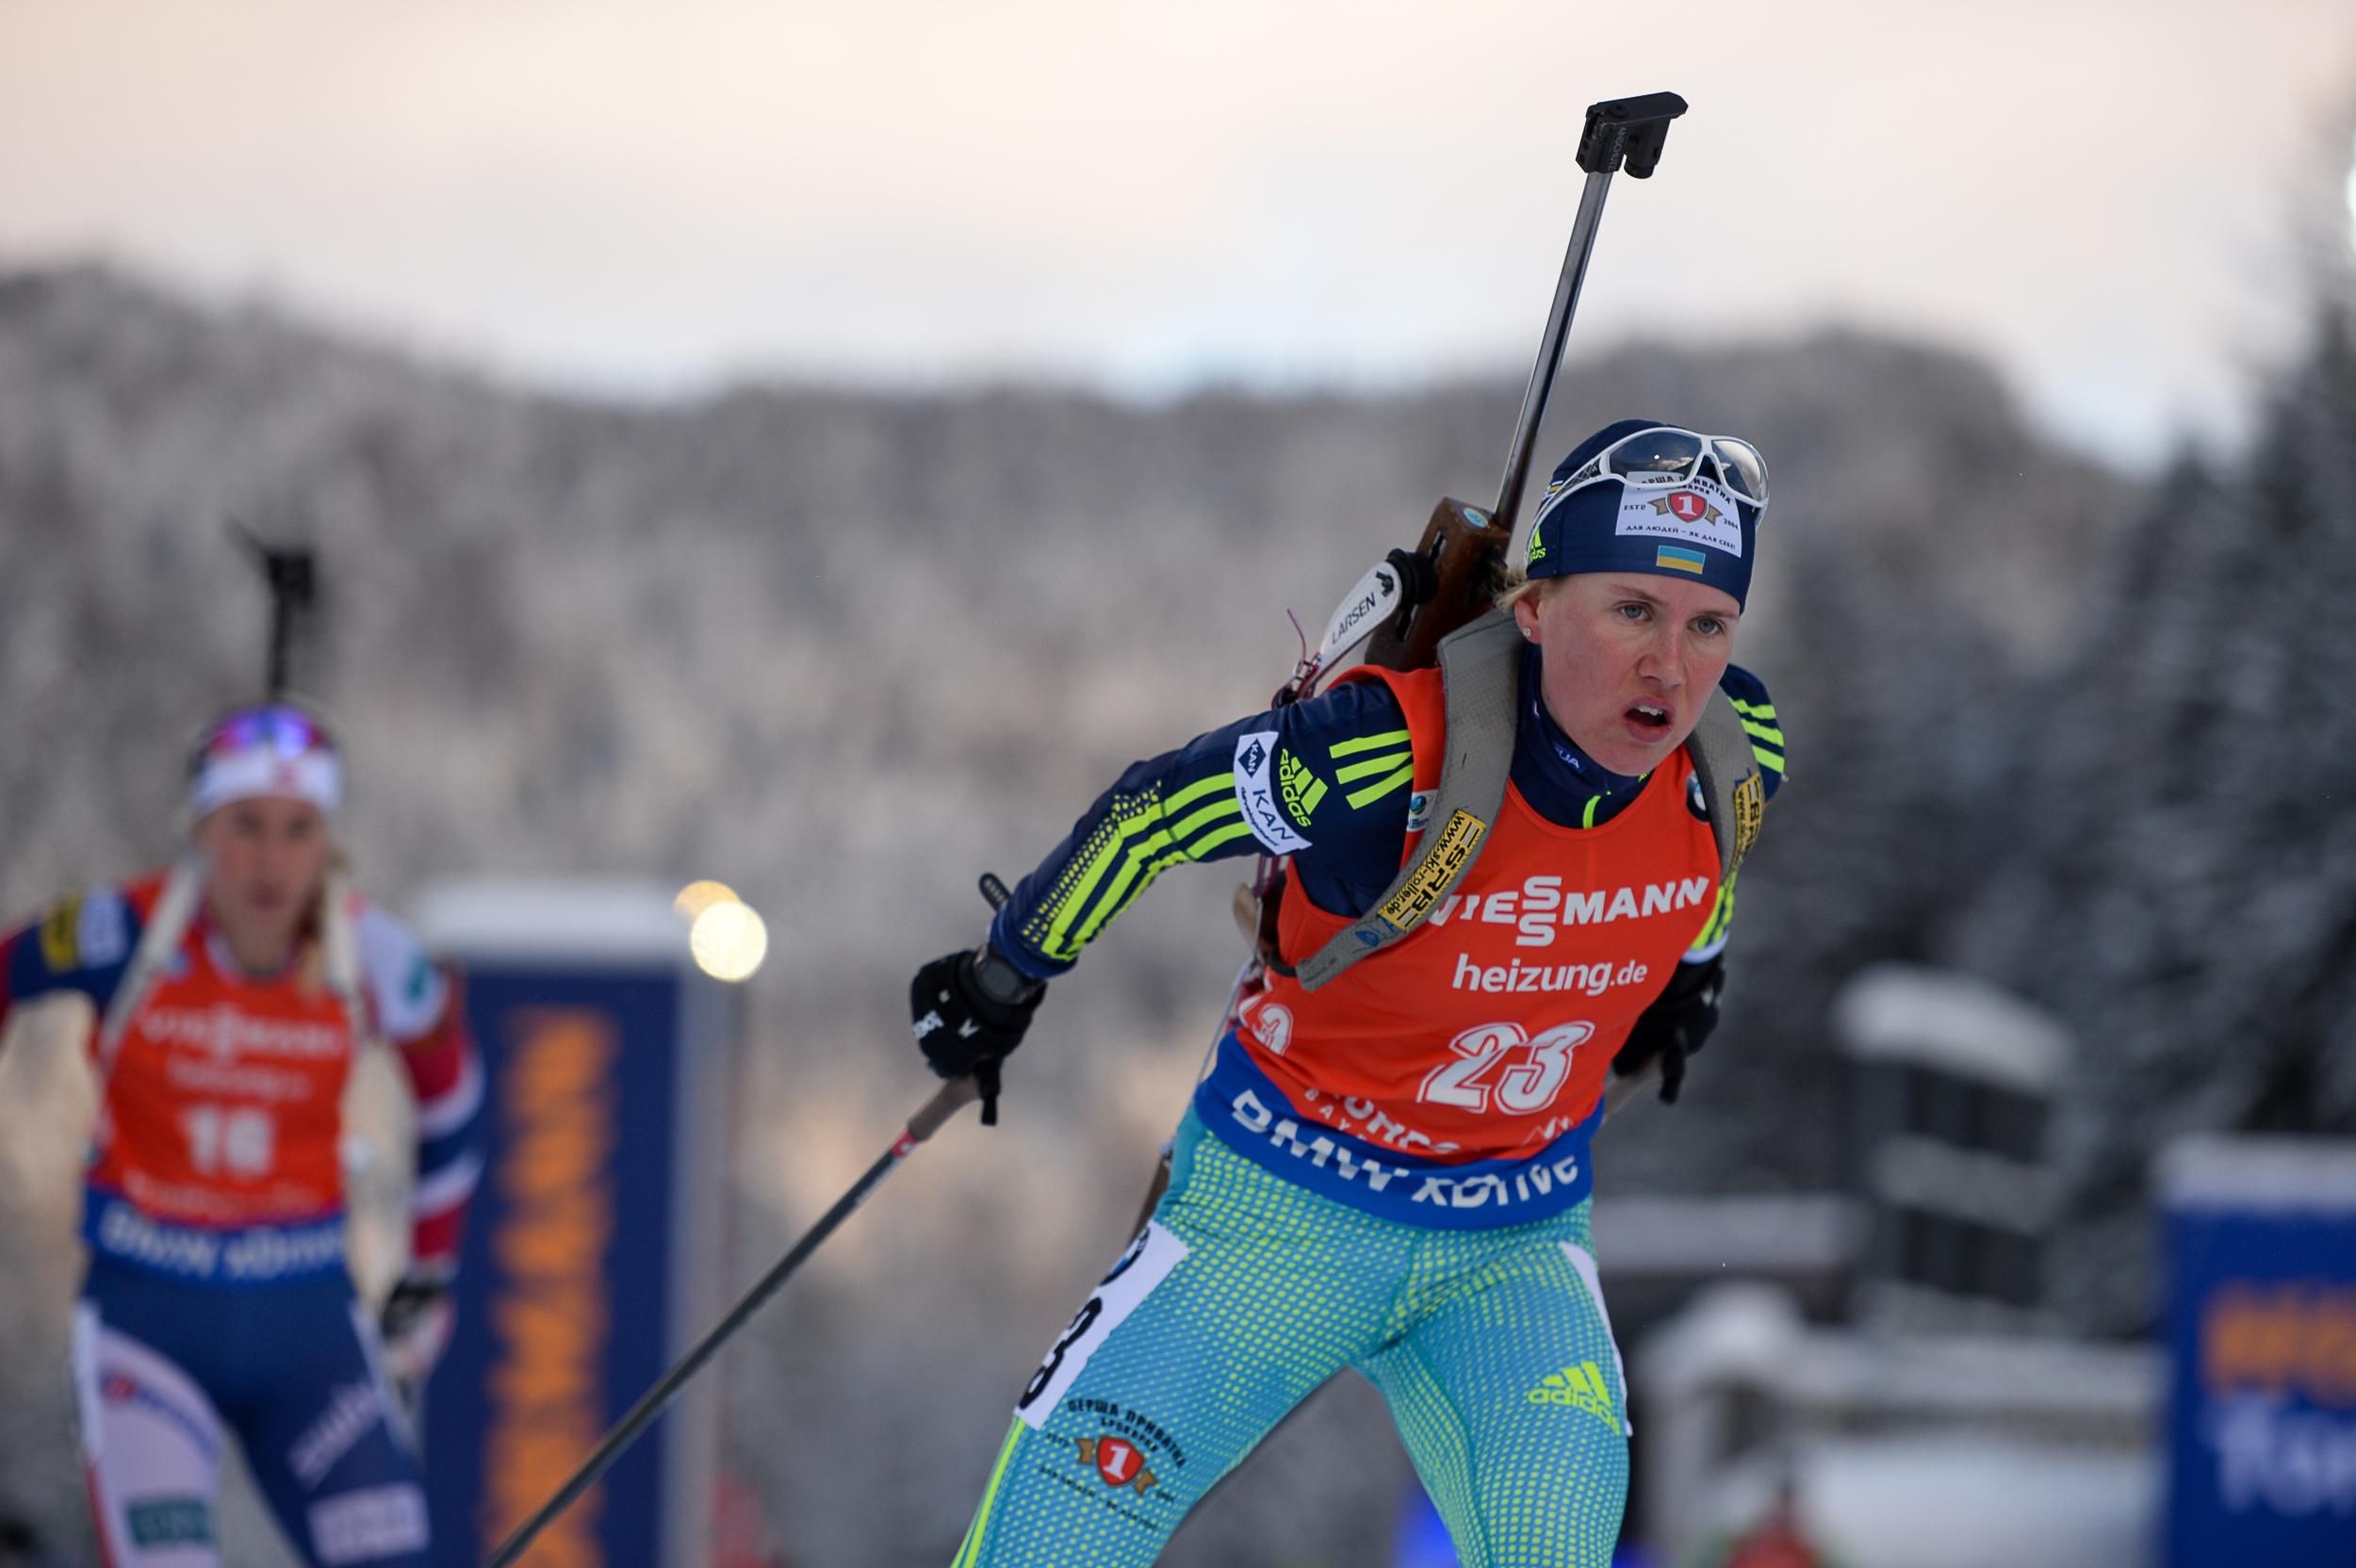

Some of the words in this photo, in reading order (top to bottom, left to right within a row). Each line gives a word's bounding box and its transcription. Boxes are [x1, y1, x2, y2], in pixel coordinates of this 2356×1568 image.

[1678, 495, 1697, 516] 1
[1332, 592, 1376, 645] LARSEN
[1248, 743, 1259, 773] KAN
[1280, 748, 1311, 827] adidas
[1252, 789, 1295, 840] KAN
[1452, 954, 1647, 996] heizung.de
[1417, 1021, 1595, 1115] 23
[1528, 1387, 1621, 1436] adidas
[1102, 1445, 1131, 1480] 1
